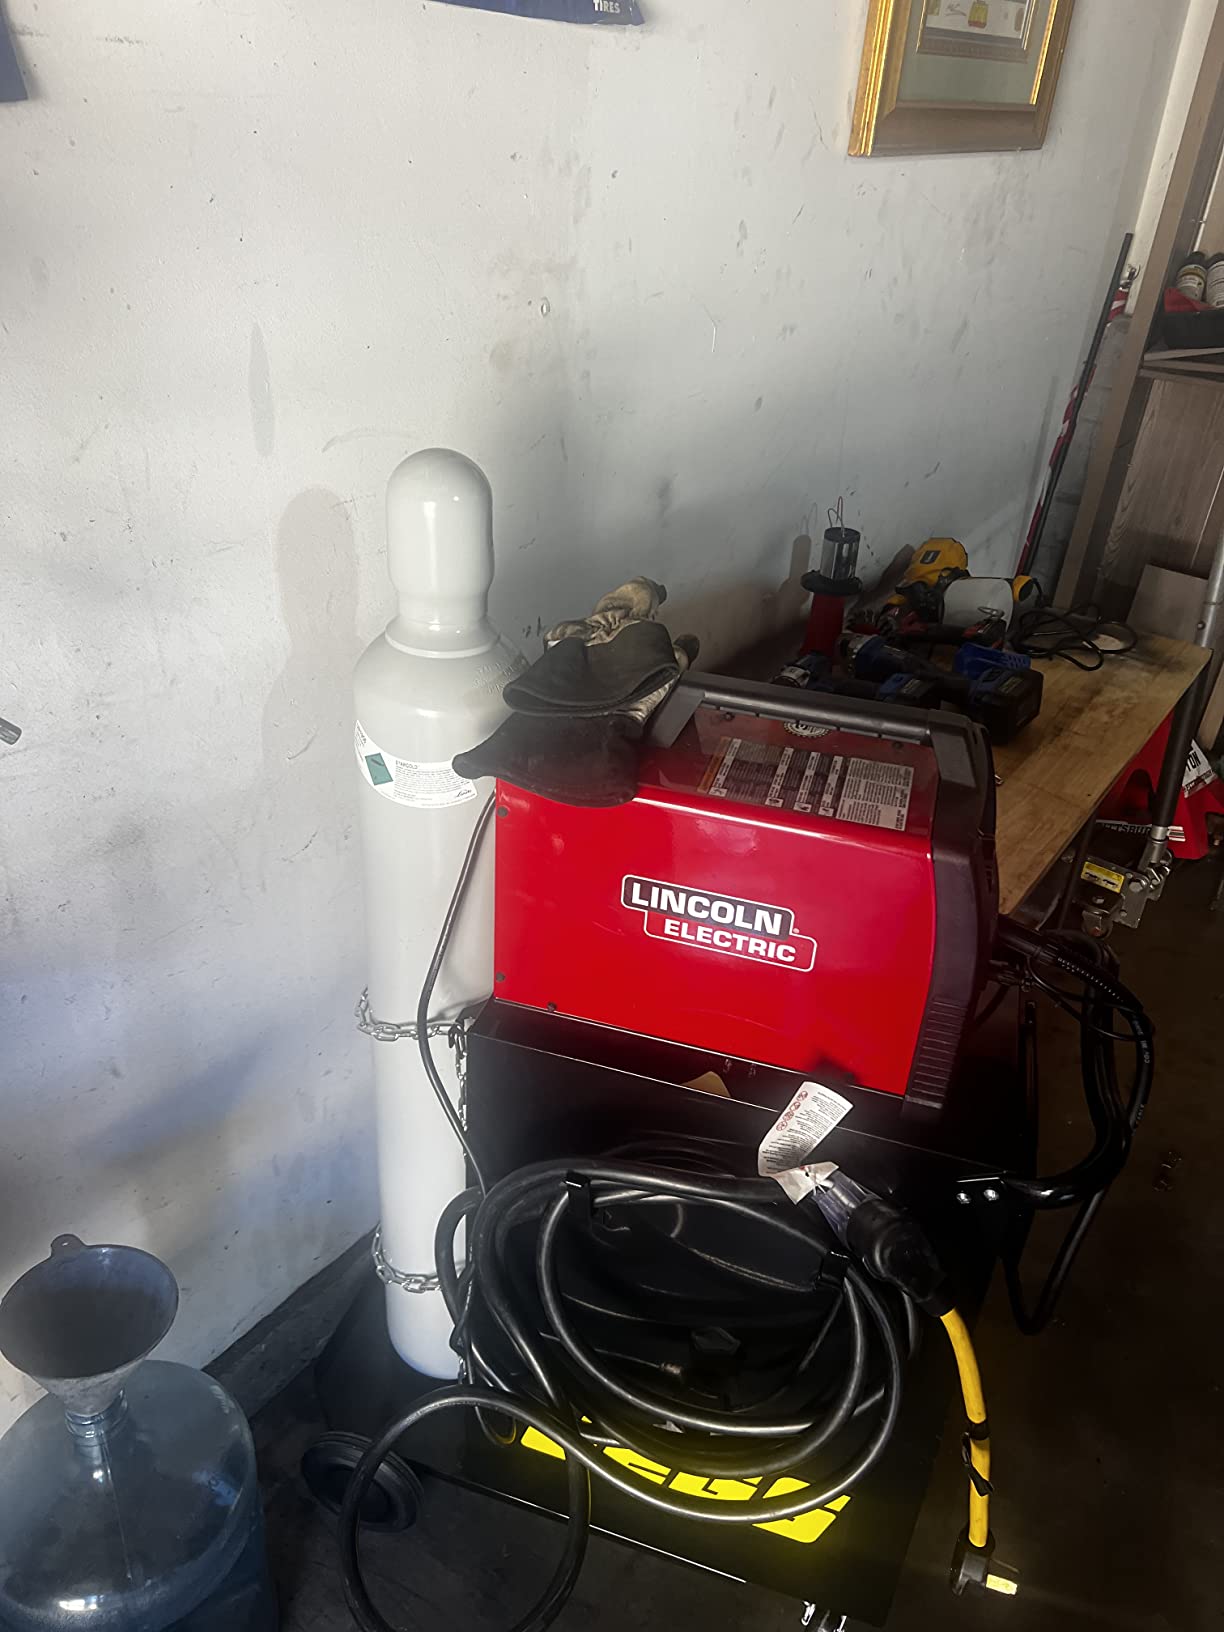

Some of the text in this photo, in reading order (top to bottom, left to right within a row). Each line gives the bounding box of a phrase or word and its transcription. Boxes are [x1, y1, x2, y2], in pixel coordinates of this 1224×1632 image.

[593, 0, 620, 13] TIRES
[631, 882, 782, 935] LINCOLN
[664, 918, 796, 962] ELECTRIC
